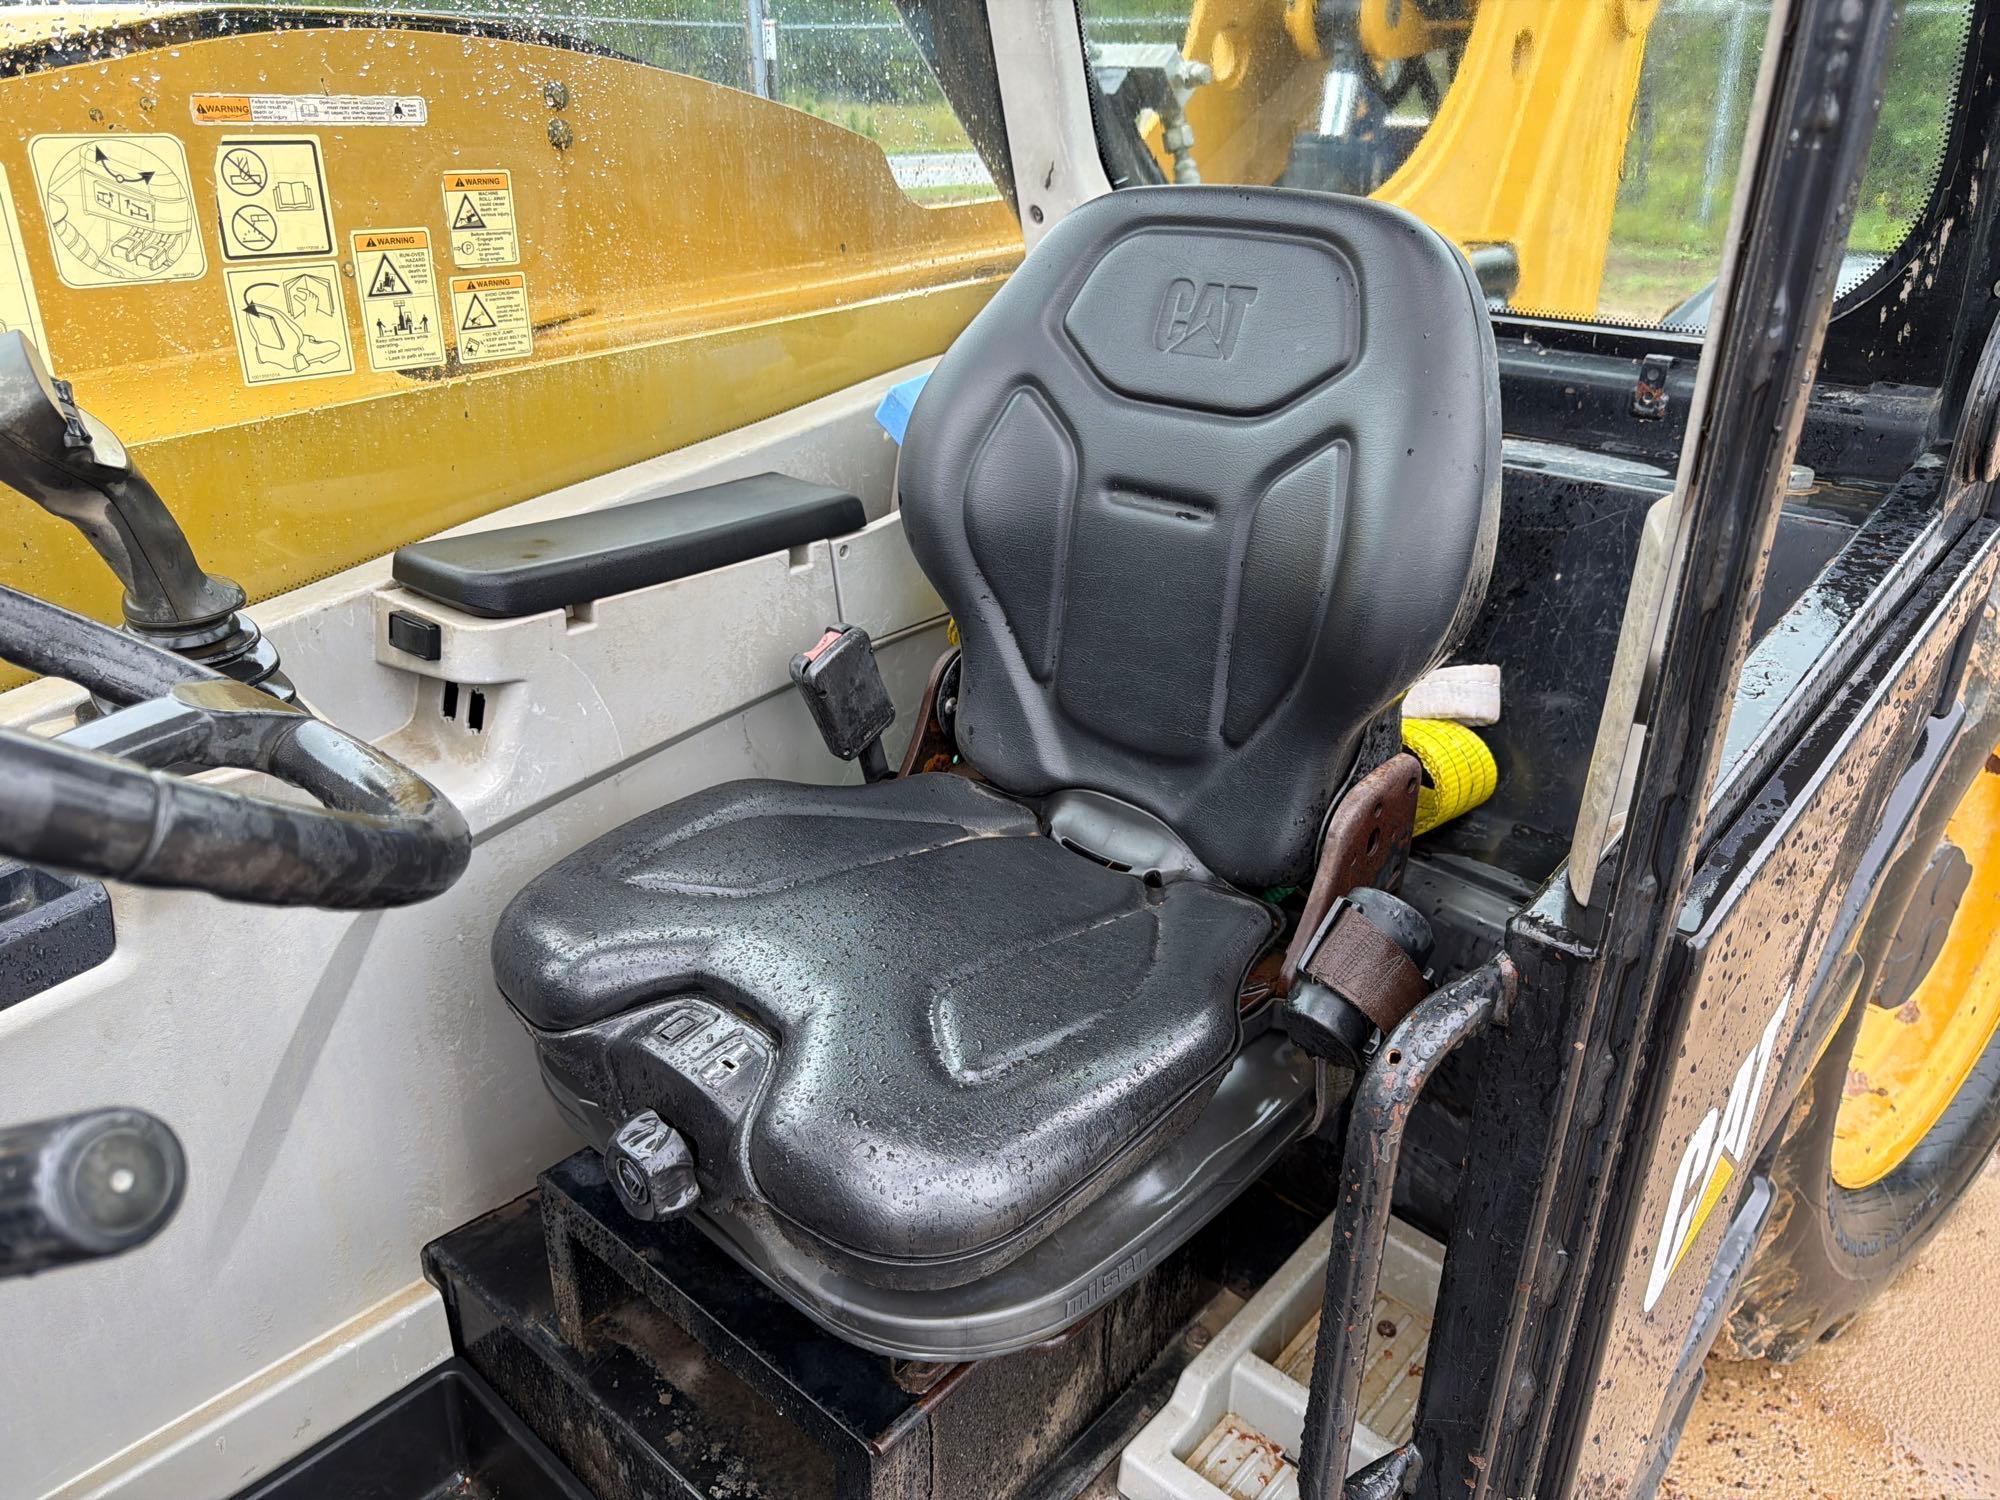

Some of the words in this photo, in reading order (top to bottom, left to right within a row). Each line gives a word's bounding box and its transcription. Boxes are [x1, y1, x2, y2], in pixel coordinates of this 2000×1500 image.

[206, 105, 249, 114] WARNING
[465, 178, 500, 186] WARNING
[377, 237, 415, 245] WARNING
[477, 279, 510, 287] WARNING
[1152, 278, 1258, 361] CAT
